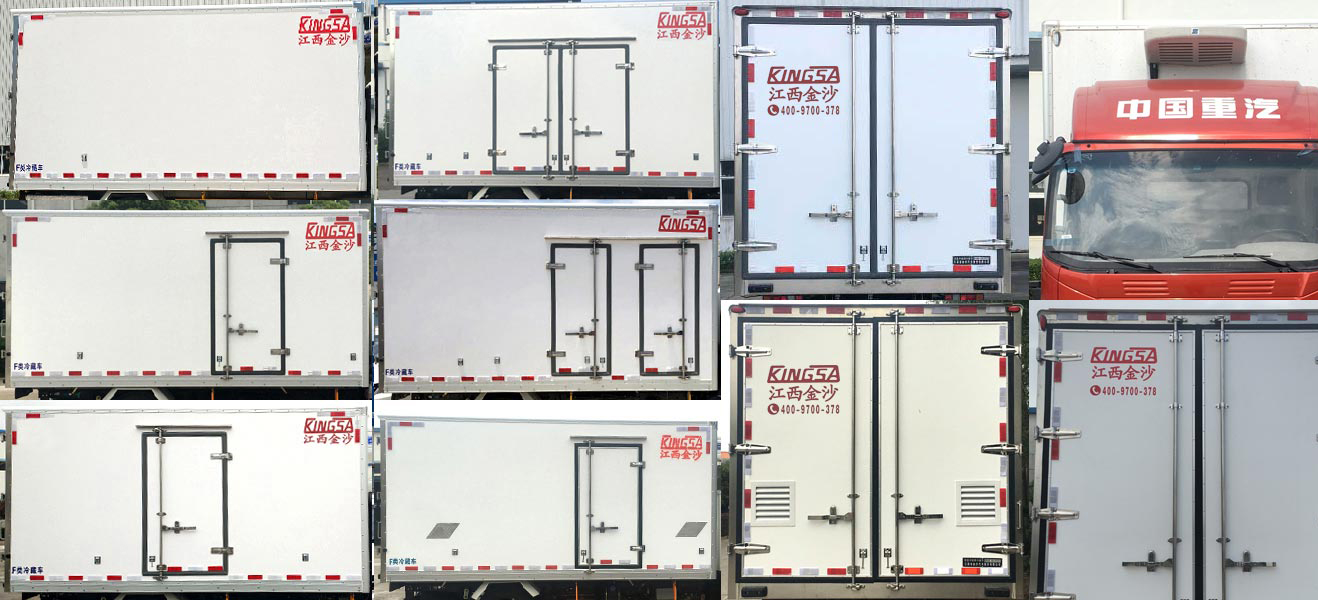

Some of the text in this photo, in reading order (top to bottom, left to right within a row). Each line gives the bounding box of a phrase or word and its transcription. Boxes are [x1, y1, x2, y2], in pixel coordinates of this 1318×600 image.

[298, 15, 351, 34] KINGSA
[657, 11, 707, 29] KINGSA
[298, 33, 351, 47] 江西金沙
[656, 28, 707, 40] 江西金沙
[764, 65, 841, 85] KINGSA
[768, 85, 839, 103] 江西金沙
[780, 105, 840, 116] 400-9700-378
[1116, 96, 1281, 120] 中国重汽
[305, 221, 356, 240] KINGSA
[658, 214, 707, 233] KINGSA
[305, 239, 356, 252] 江西金沙
[1090, 346, 1158, 364] KINGSA
[766, 364, 841, 384] KINGSA
[1091, 364, 1157, 382] 江西金沙
[768, 383, 839, 403] 江西金沙
[1102, 386, 1157, 396] 400-9700-378
[780, 404, 840, 415] 400-9700-378
[303, 417, 354, 434] KINGSA
[303, 432, 354, 446] 江西金沙
[660, 434, 703, 450] KINGSA
[660, 449, 703, 461] 江西金沙
